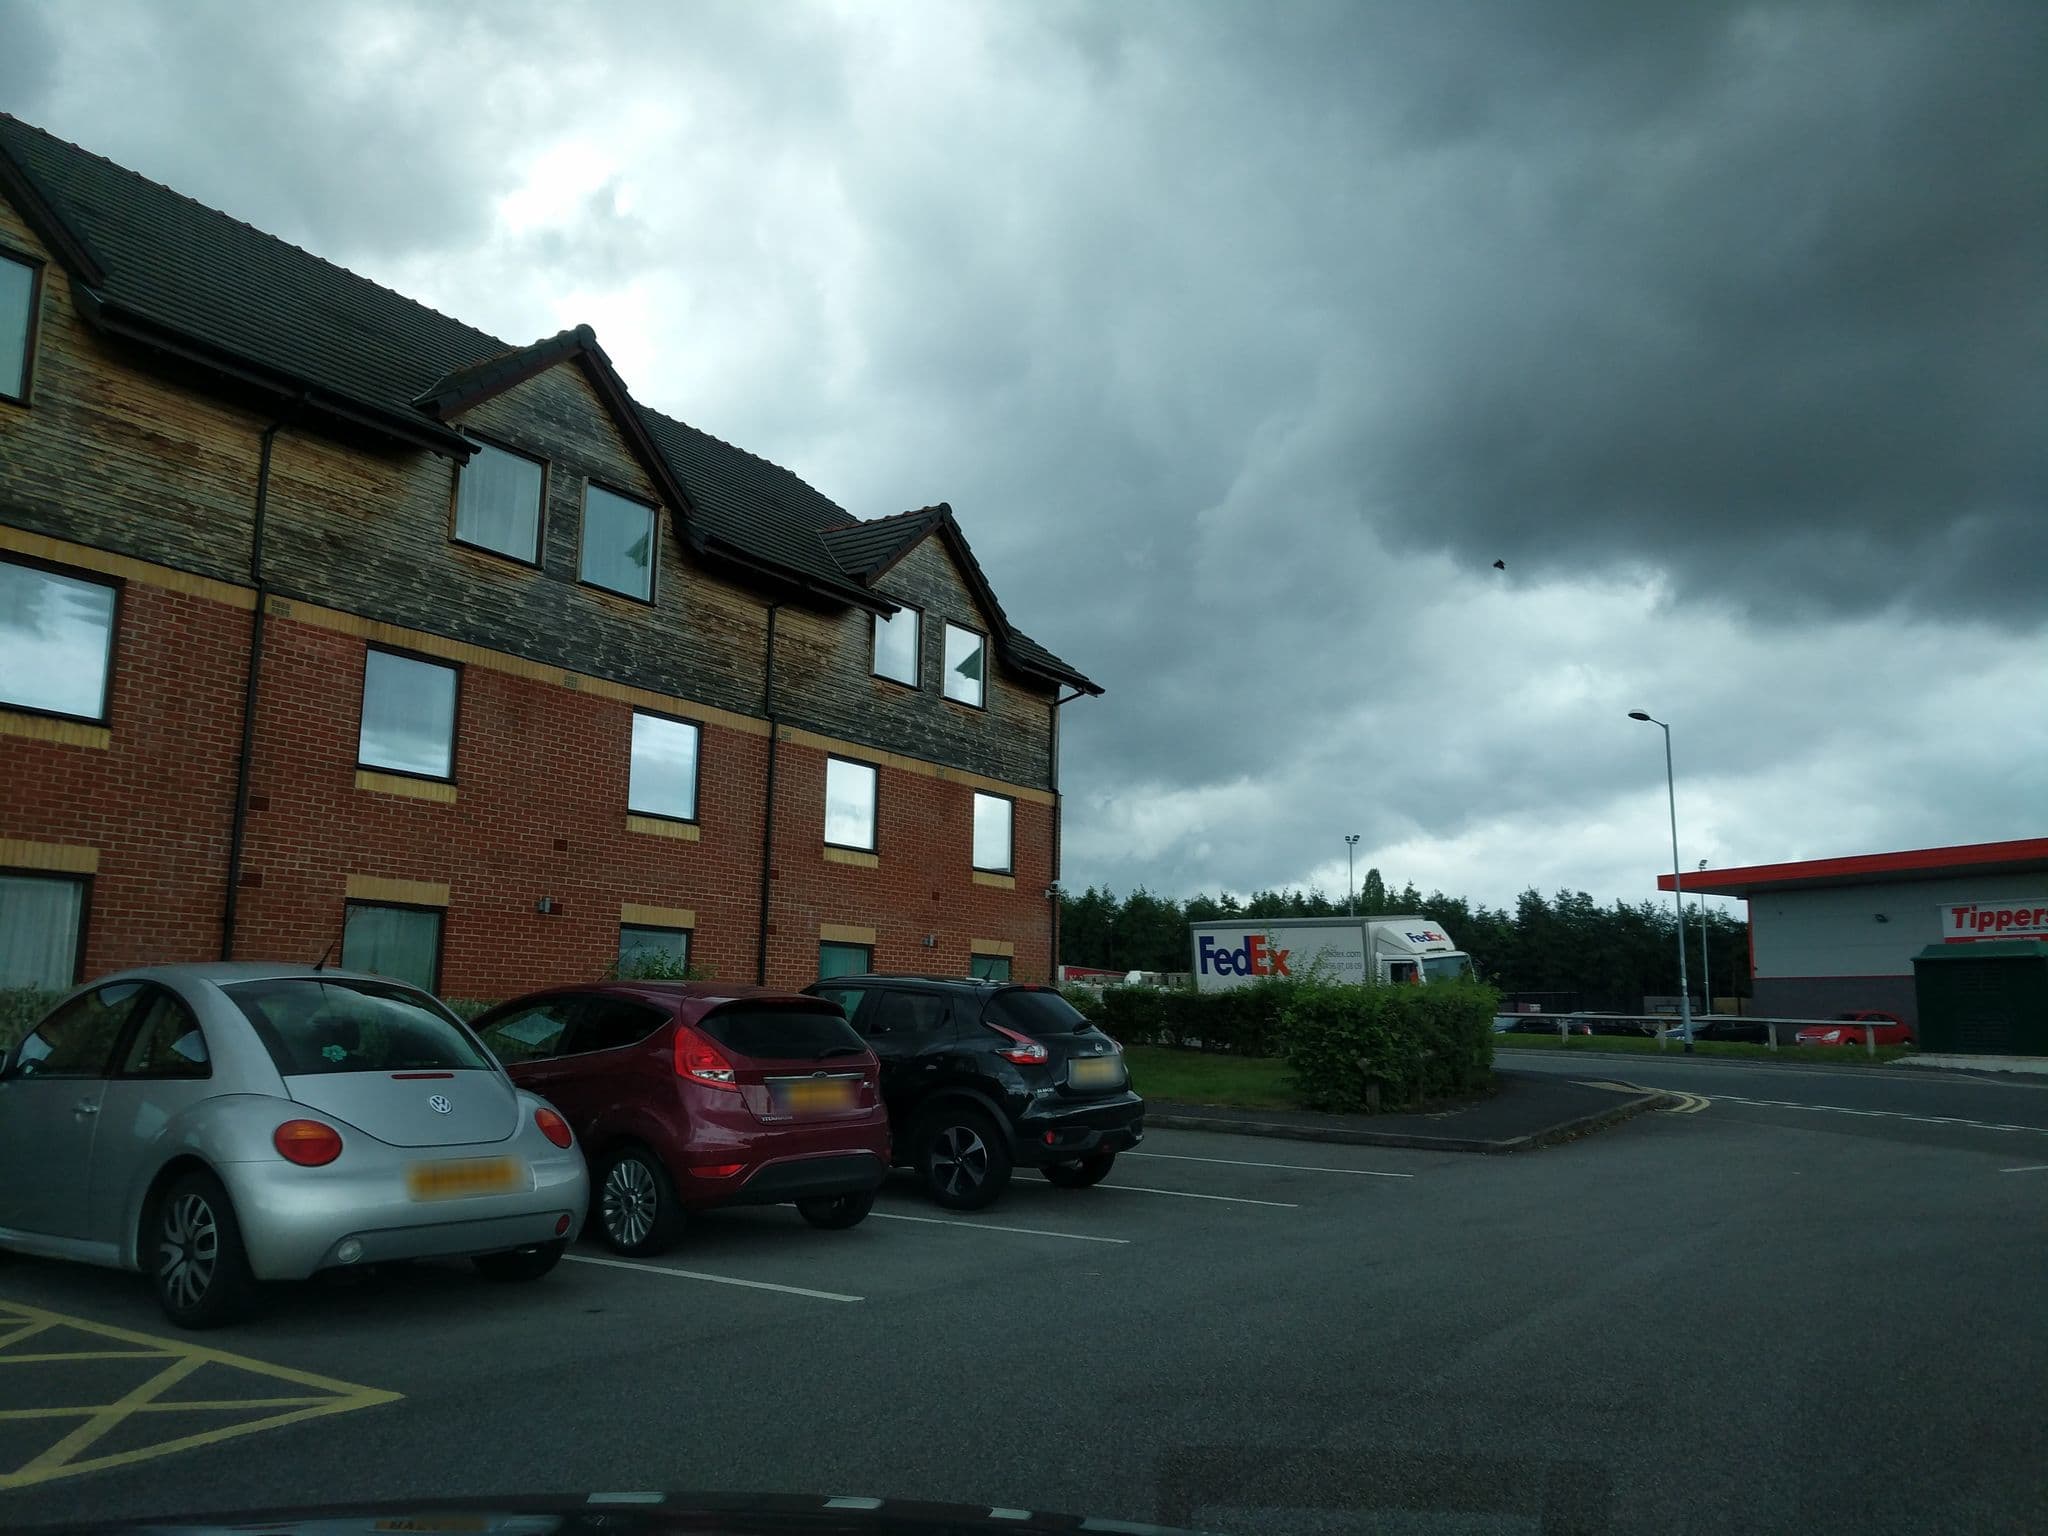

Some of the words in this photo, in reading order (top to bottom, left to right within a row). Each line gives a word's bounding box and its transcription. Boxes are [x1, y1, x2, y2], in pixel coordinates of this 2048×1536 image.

[1951, 904, 2048, 932] Tipper
[1405, 931, 1446, 943] FedEx
[1199, 935, 1291, 977] FedEx
